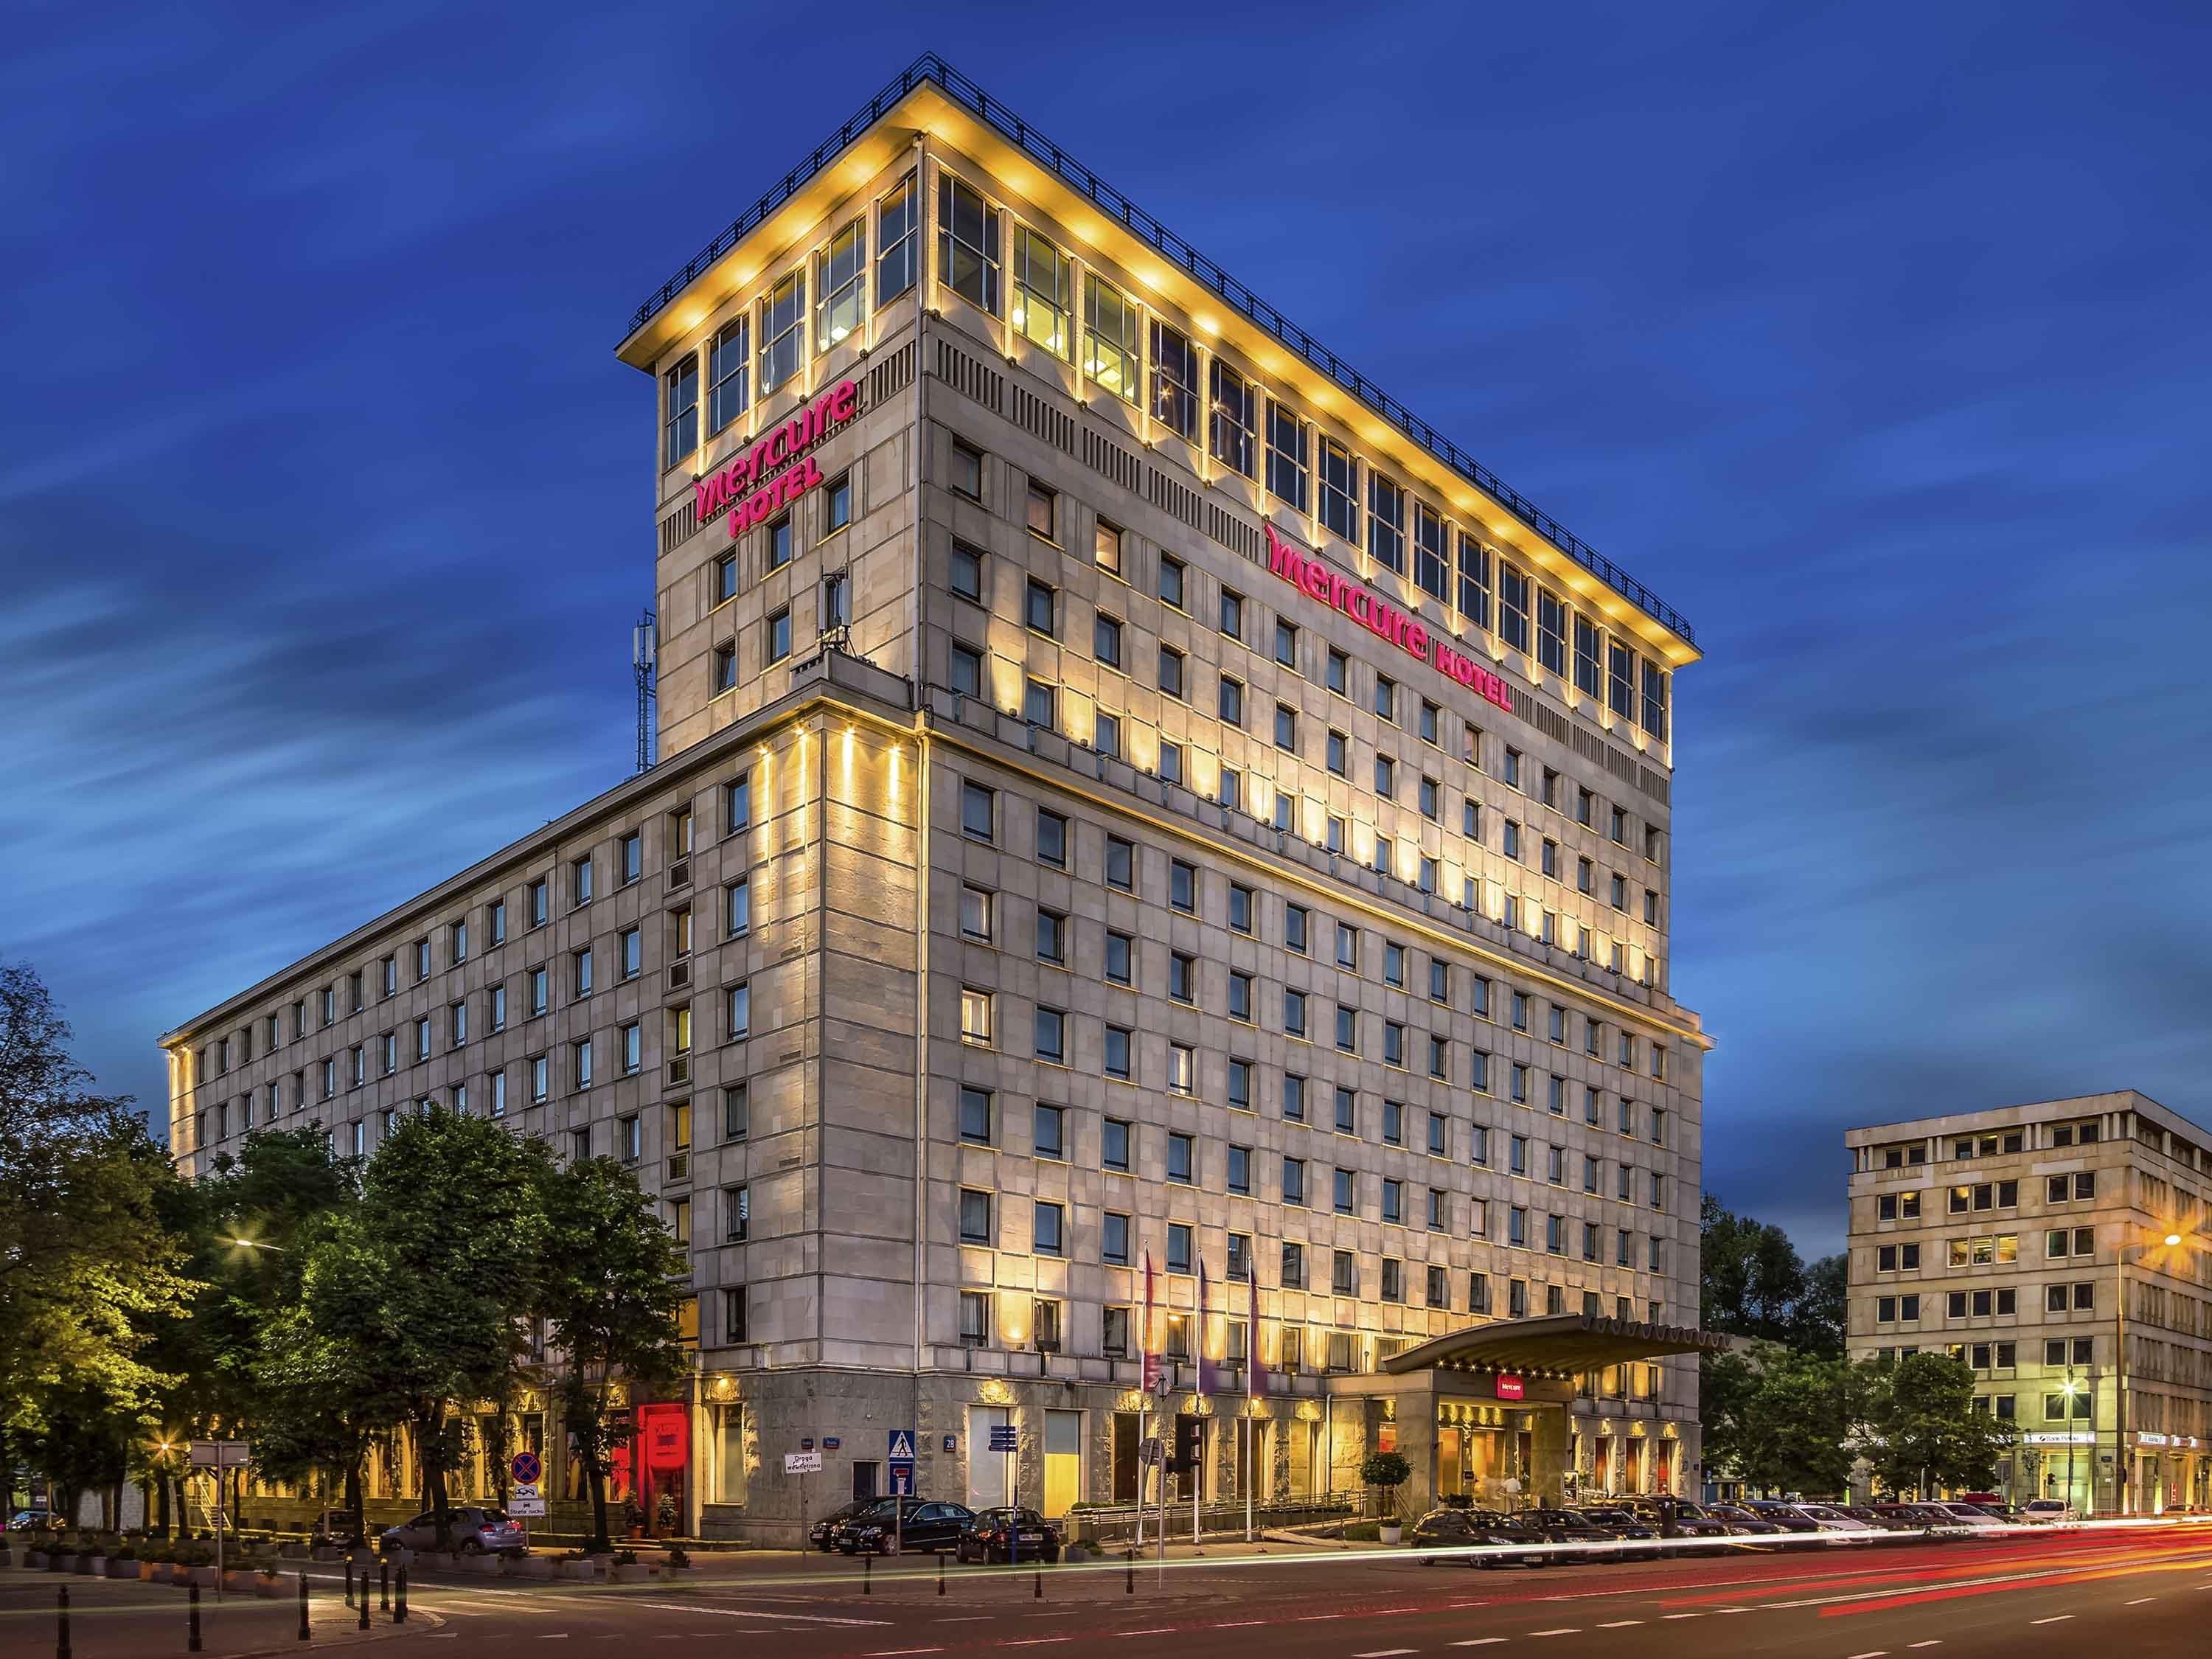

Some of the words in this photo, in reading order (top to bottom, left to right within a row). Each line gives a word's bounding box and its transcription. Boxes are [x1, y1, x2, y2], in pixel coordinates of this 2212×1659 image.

[728, 456, 824, 538] HOTEL
[1435, 643, 1513, 713] HOTEL
[947, 1439, 955, 1448] 28
